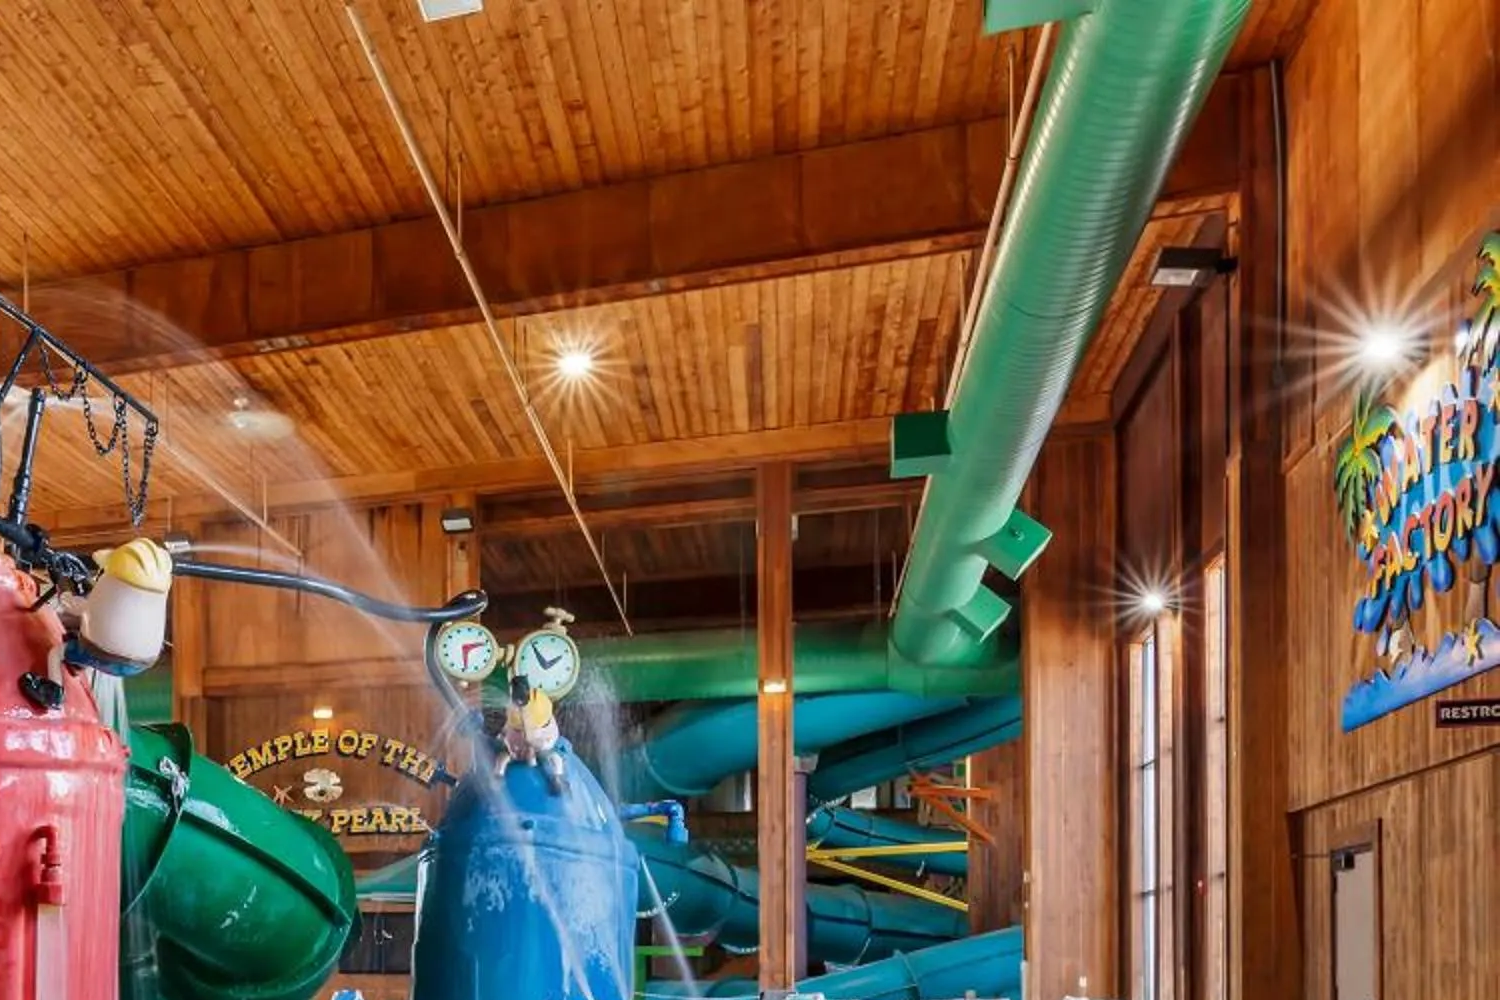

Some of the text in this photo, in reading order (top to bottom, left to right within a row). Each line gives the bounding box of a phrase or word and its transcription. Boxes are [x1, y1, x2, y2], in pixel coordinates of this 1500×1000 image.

[1375, 400, 1478, 526] WATER
[1365, 463, 1493, 600] FACTORY
[224, 728, 329, 779] EMPLE
[338, 730, 379, 757] OF
[330, 807, 428, 833] PEARL
